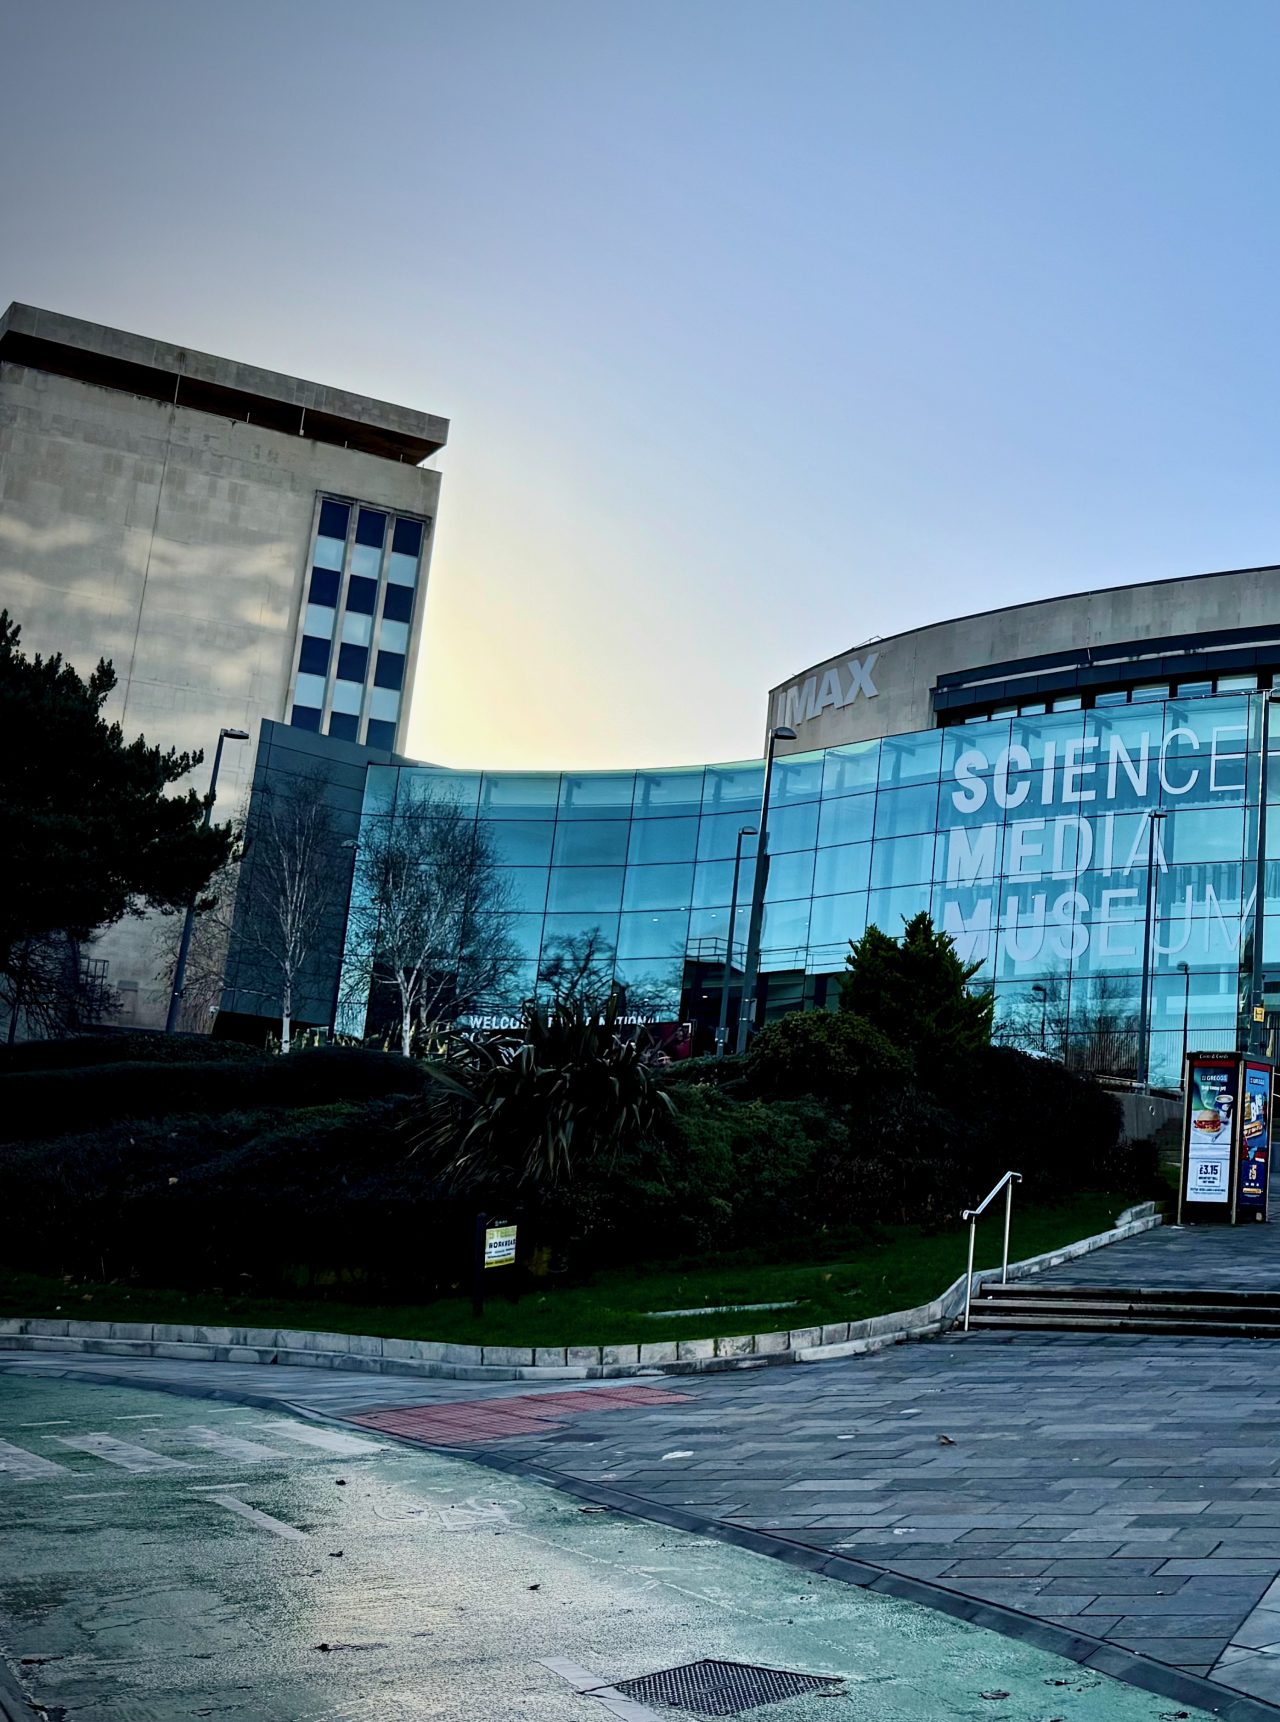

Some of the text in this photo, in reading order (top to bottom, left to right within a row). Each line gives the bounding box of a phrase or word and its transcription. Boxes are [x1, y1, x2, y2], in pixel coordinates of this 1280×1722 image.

[776, 652, 880, 728] IMAX
[951, 724, 1249, 814] SCIENCE
[944, 808, 1169, 889] MEDIA
[942, 883, 1259, 966] MUSEUM
